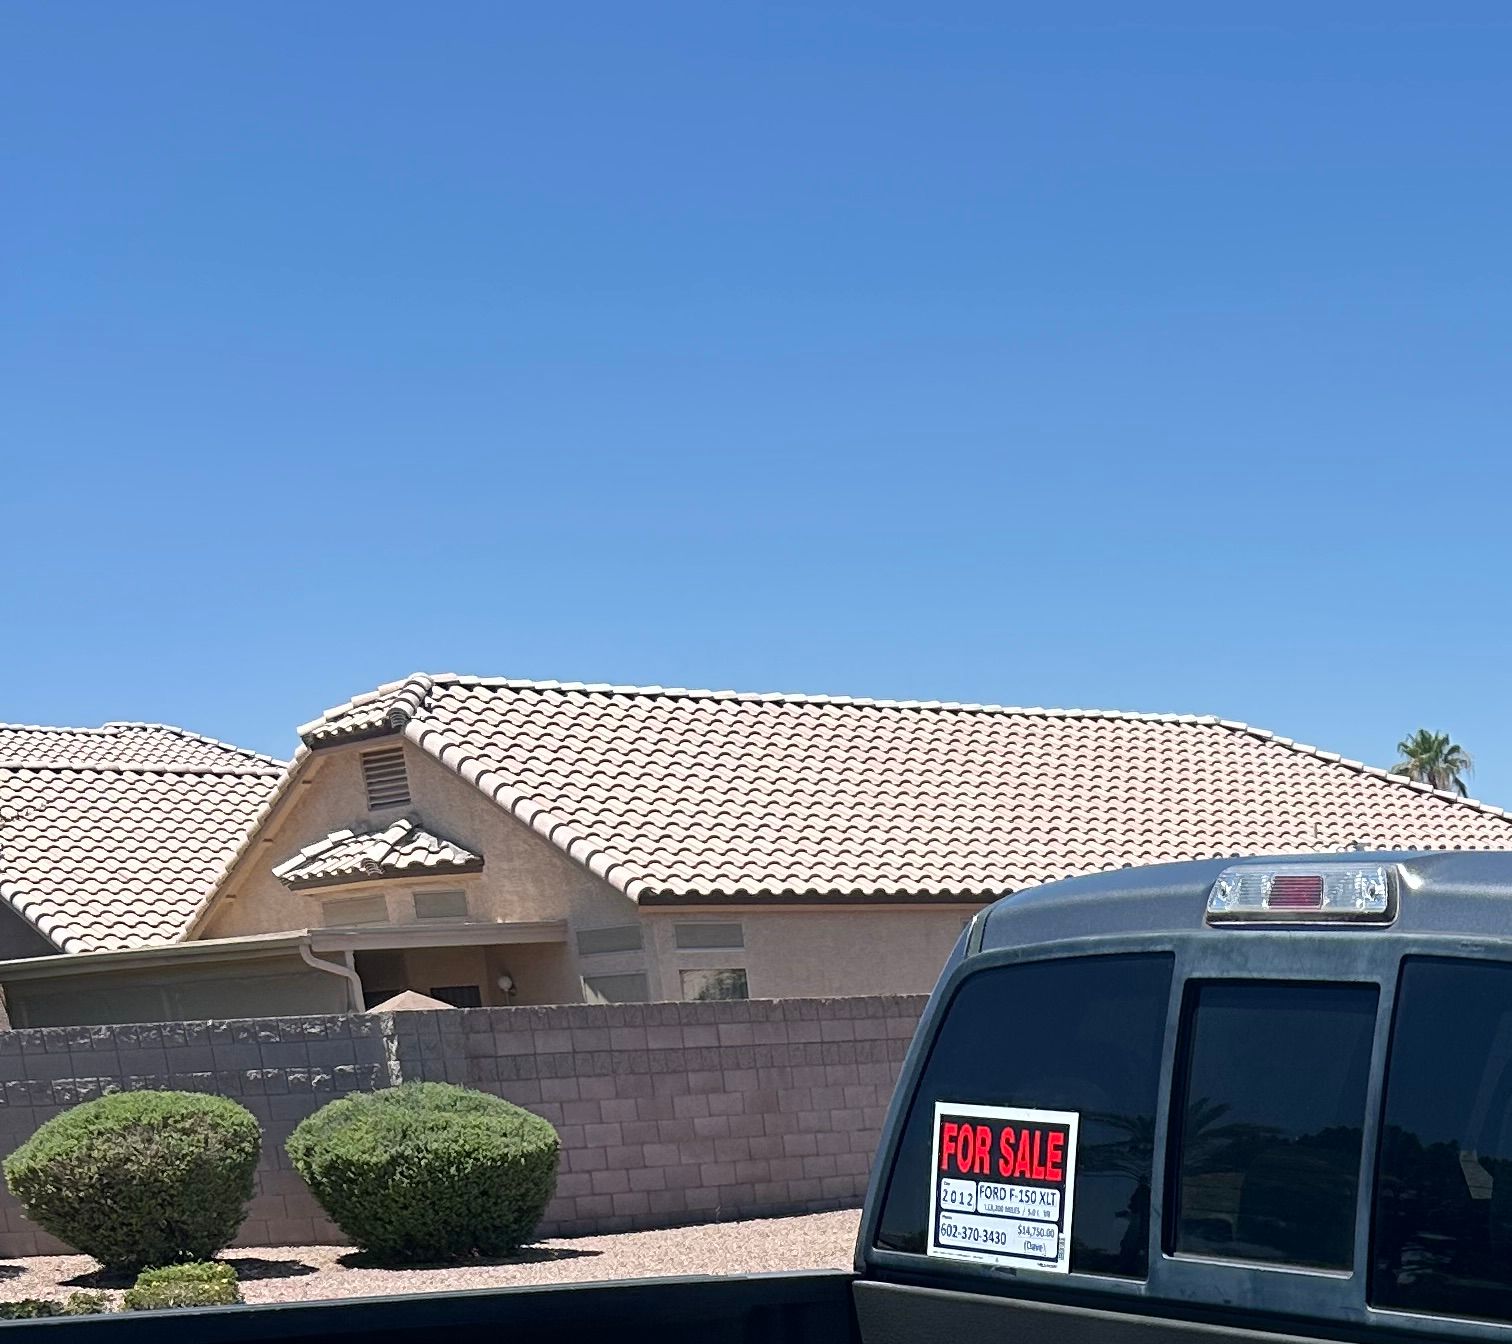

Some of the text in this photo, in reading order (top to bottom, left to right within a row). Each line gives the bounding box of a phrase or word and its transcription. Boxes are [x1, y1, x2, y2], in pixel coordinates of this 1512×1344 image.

[940, 1122, 1065, 1181] FOR SALE
[942, 1188, 973, 1206] 2012
[979, 1185, 1056, 1206] FORD F-150 XLT
[940, 1222, 1007, 1246] 602-370-3430
